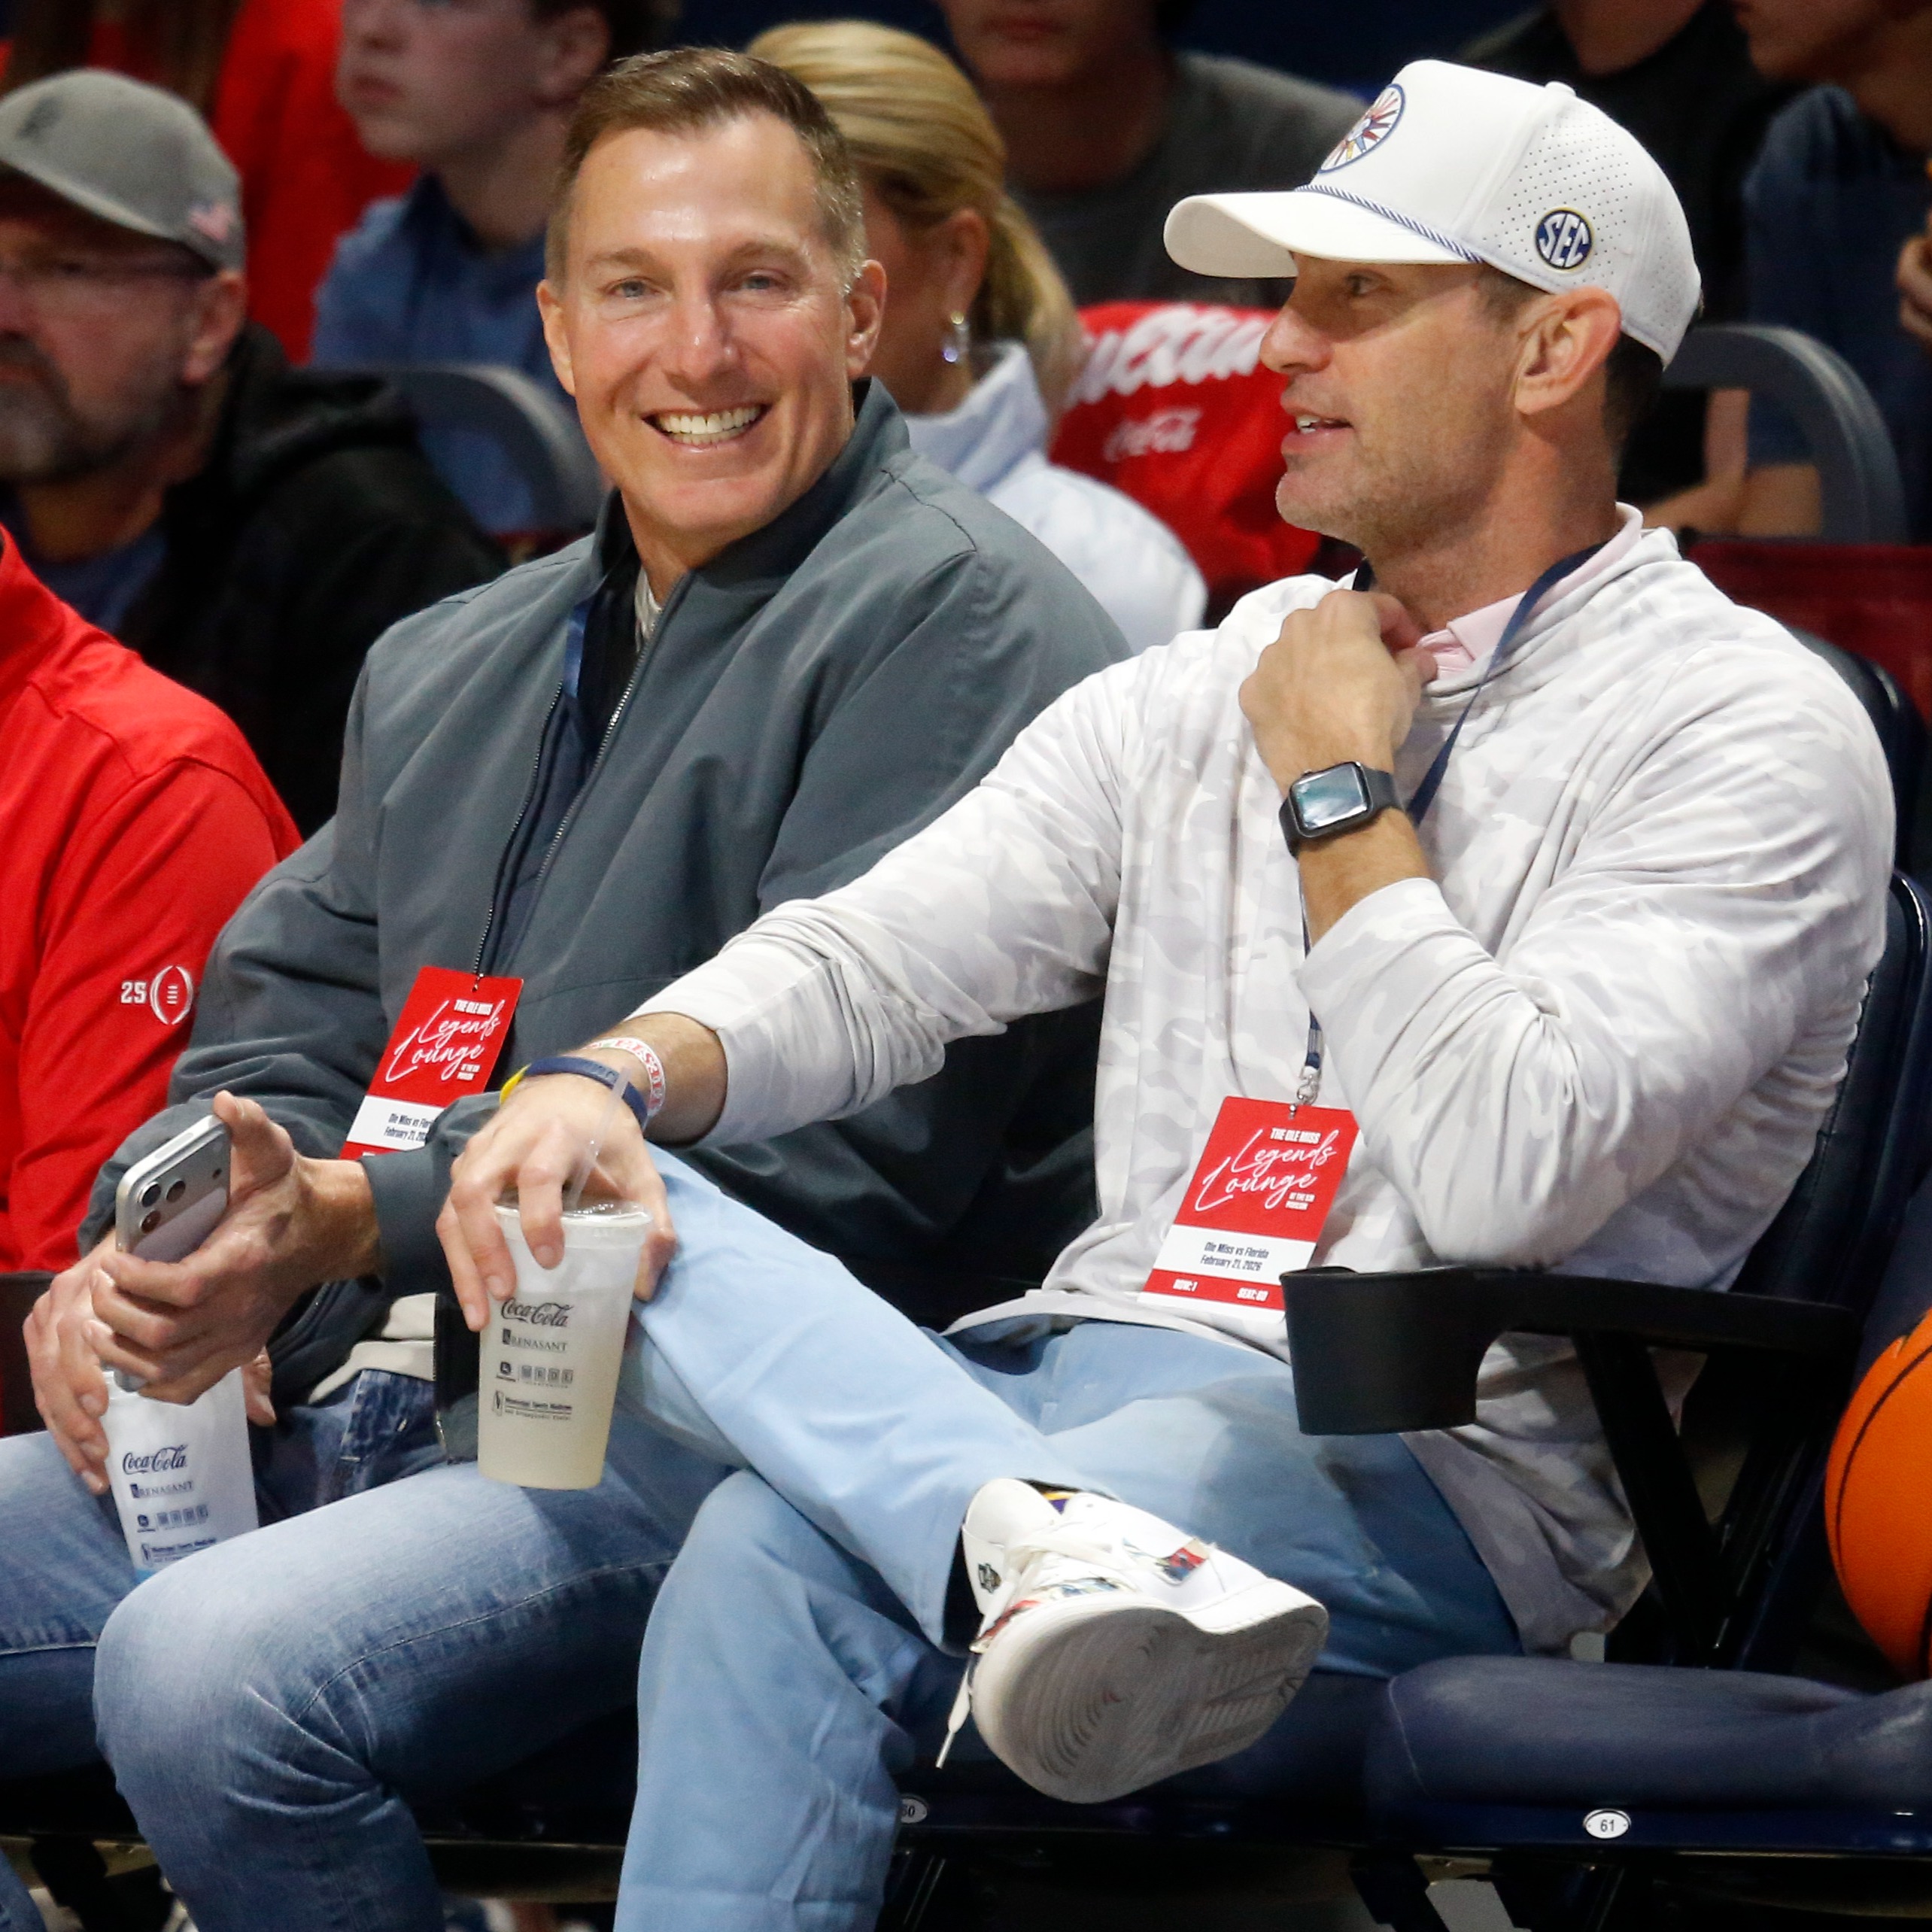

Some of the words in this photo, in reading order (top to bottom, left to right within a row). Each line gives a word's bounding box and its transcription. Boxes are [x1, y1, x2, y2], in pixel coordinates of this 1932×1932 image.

[1539, 212, 1590, 268] SEC
[120, 981, 147, 1004] 25
[418, 999, 506, 1048] Legends
[385, 1028, 485, 1083] Lounge
[399, 1115, 412, 1125] Miss
[1270, 1128, 1287, 1141] THE
[1284, 1129, 1302, 1142] OLE
[1231, 1129, 1339, 1177] Legends
[1195, 1156, 1318, 1212] Lounge
[1200, 1254, 1232, 1269] February
[1217, 1244, 1235, 1254] Miss
[1235, 1247, 1244, 1256] vs
[1244, 1247, 1270, 1259] Florida
[501, 1297, 574, 1327] Coca-Cola
[511, 1335, 567, 1352] RENASANT
[123, 1444, 188, 1475] Coca-Cola
[139, 1480, 194, 1496] RENASANT
[1600, 1818, 1615, 1832] 61
